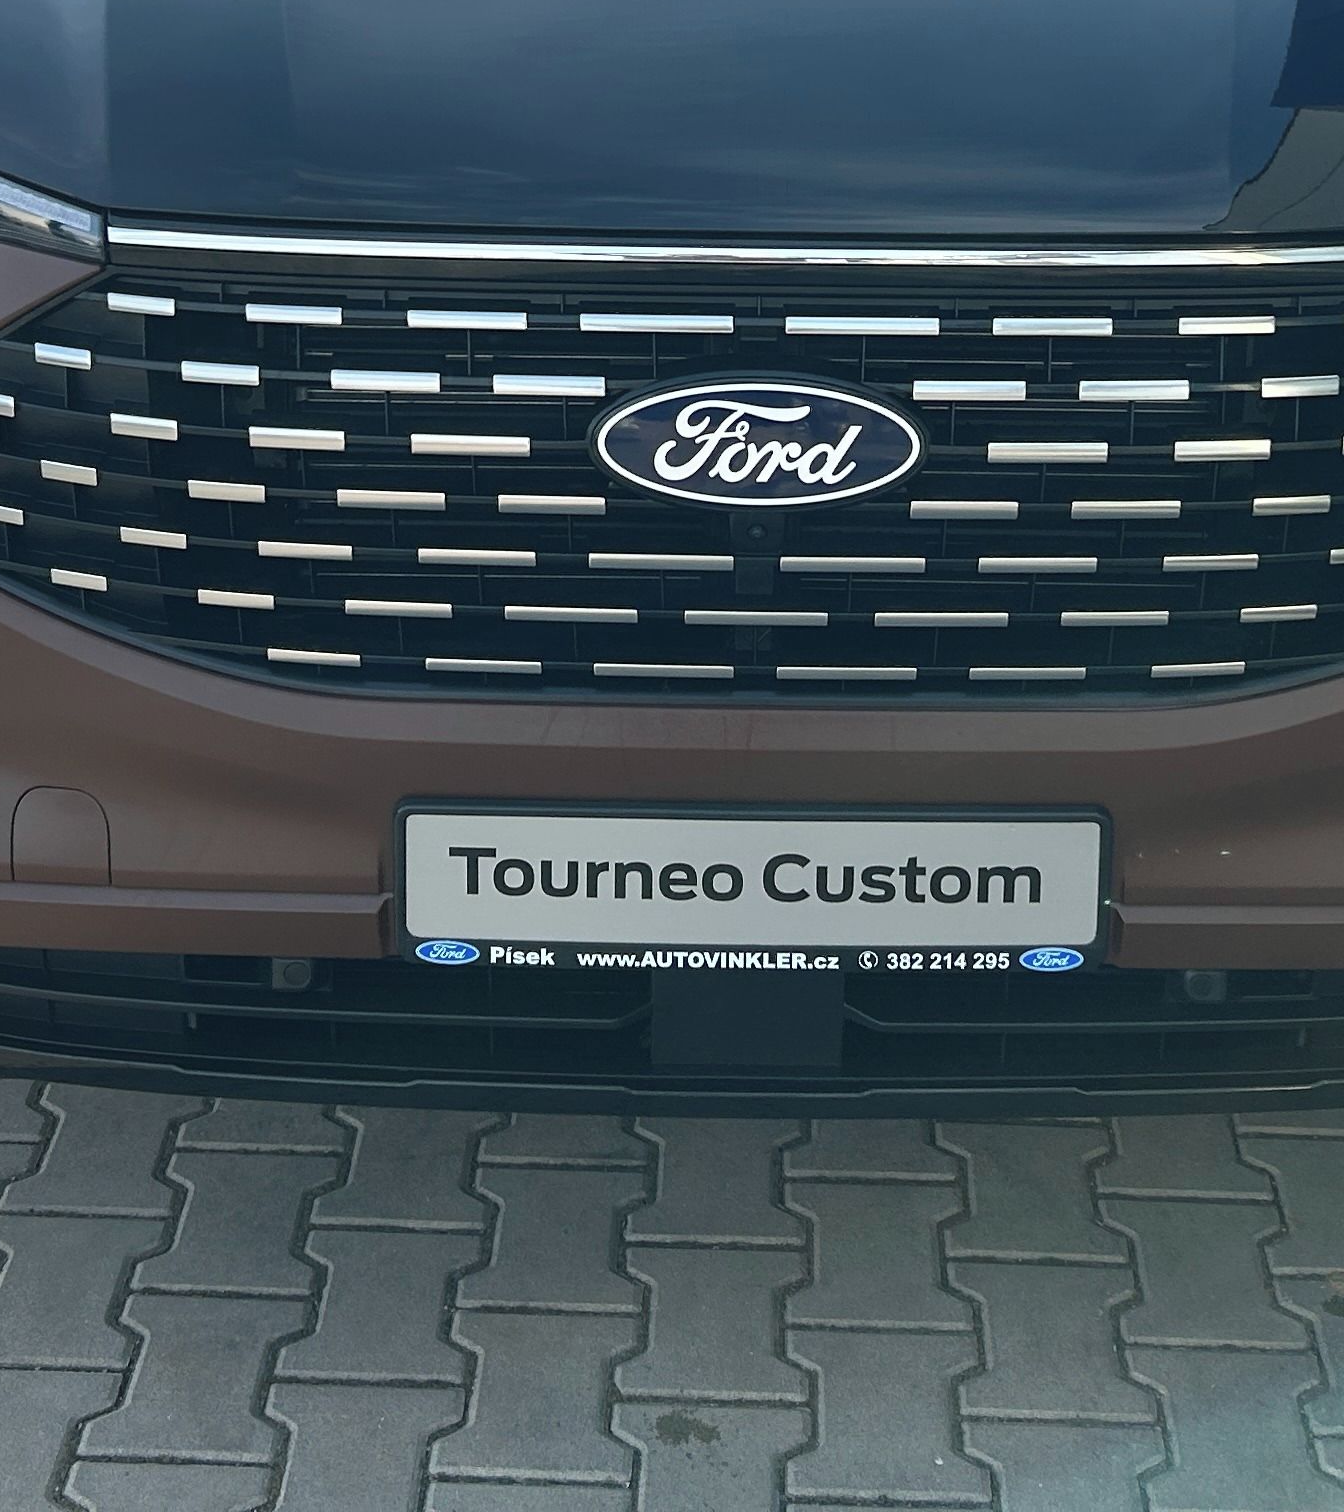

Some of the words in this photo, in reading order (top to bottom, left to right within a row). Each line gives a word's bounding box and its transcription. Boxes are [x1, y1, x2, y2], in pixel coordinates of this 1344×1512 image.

[654, 399, 863, 485] Ford
[448, 846, 744, 903] Tourneo
[762, 853, 1043, 905] Custom
[490, 946, 556, 966] Písek
[577, 950, 840, 971] www.AUTOVINKLER.cz
[886, 952, 923, 970] 382
[929, 952, 967, 971] 214
[972, 953, 1010, 971] 295
